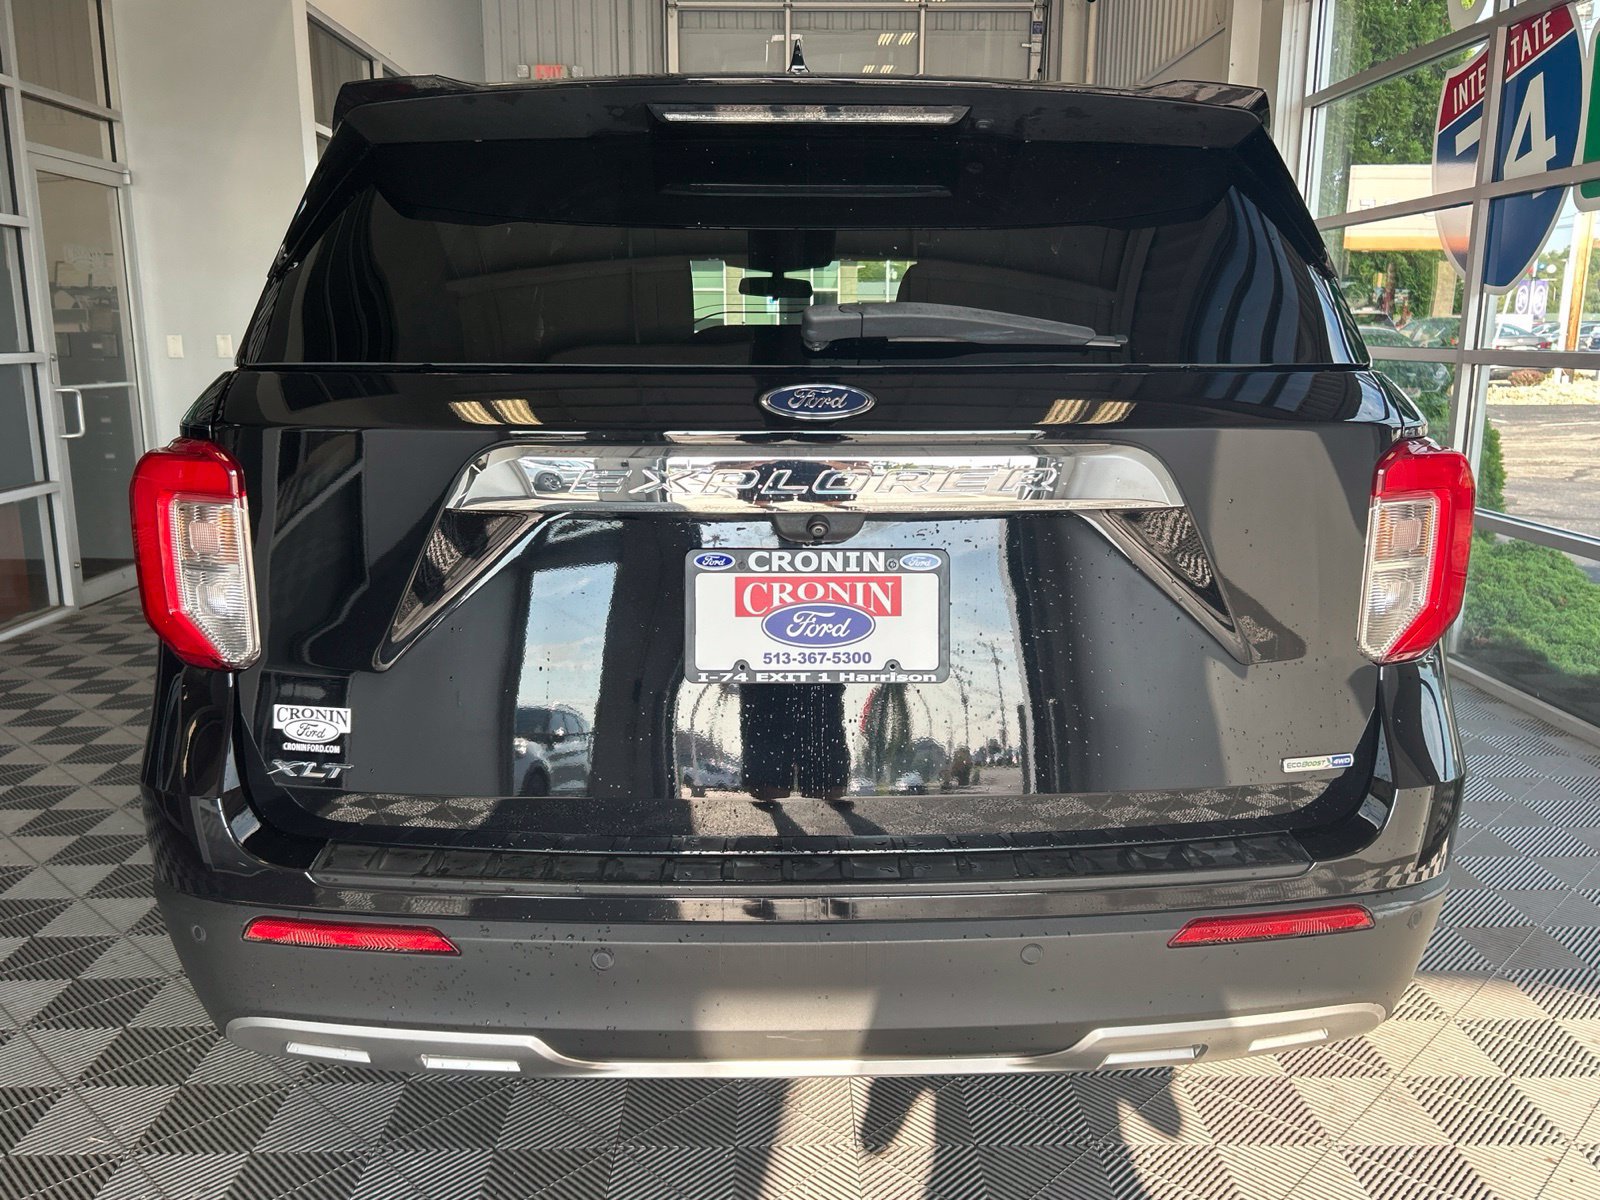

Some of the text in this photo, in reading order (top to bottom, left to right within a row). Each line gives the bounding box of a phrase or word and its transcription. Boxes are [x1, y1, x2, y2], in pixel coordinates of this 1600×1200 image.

[1453, 11, 1553, 114] INTETATE
[787, 386, 849, 409] Ford
[568, 469, 1058, 496] EXPLORER
[702, 551, 931, 572] Ford CRONIN Ford
[743, 581, 895, 615] CRONIN
[786, 611, 852, 638] Ford
[763, 652, 872, 665] 513-367-5300
[698, 672, 937, 682] I-74 EXIT 1 Harrison
[276, 706, 348, 727] CRONIN
[297, 722, 326, 738] Ford
[282, 742, 341, 754] CRONINFORD.COM
[266, 759, 355, 779] XLT
